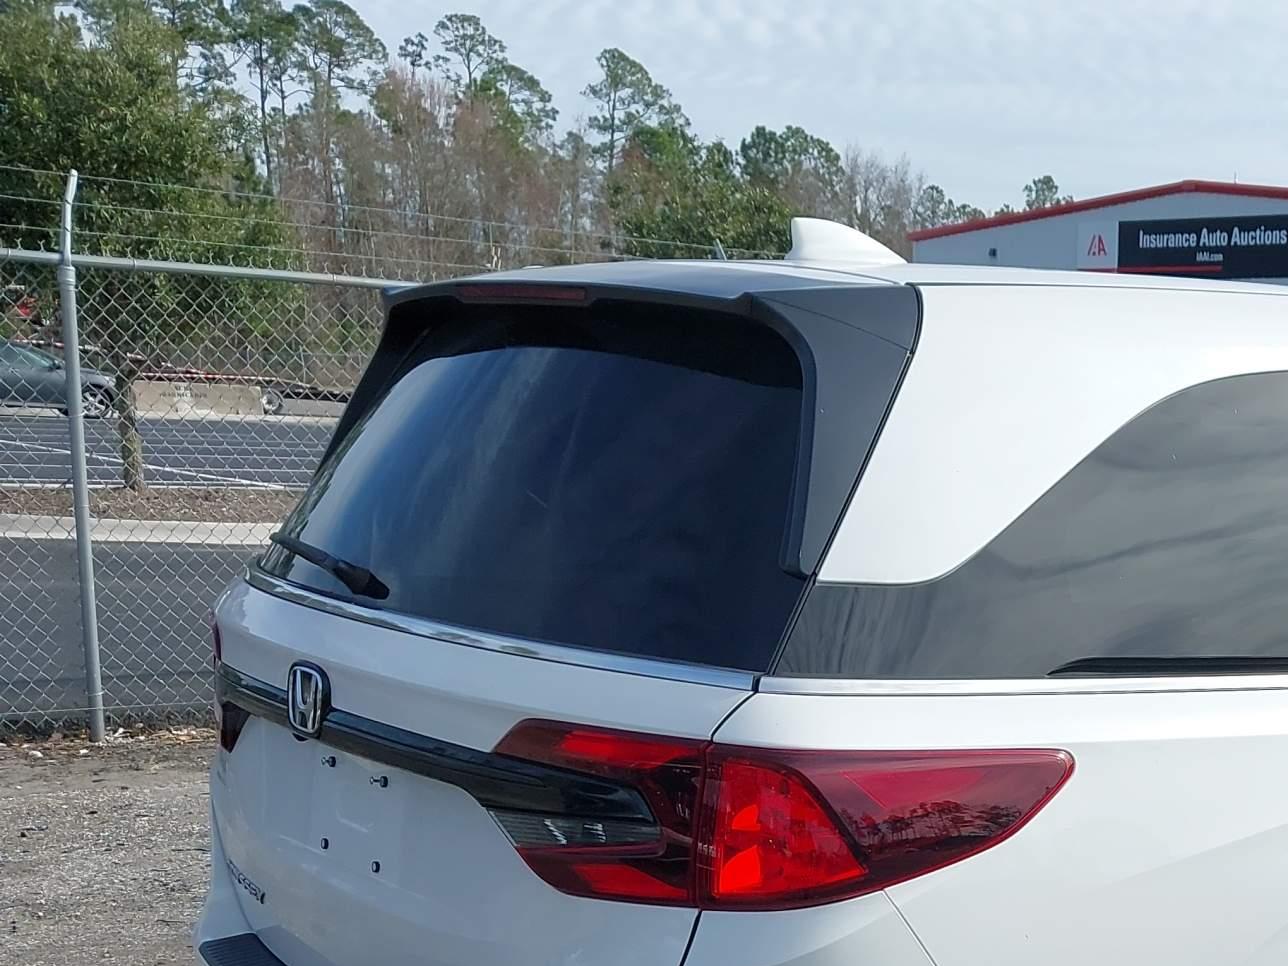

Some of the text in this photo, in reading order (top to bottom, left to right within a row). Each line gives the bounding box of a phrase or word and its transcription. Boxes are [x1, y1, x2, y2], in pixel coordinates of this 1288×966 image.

[1138, 225, 1288, 249] Insurance Auto Auctions
